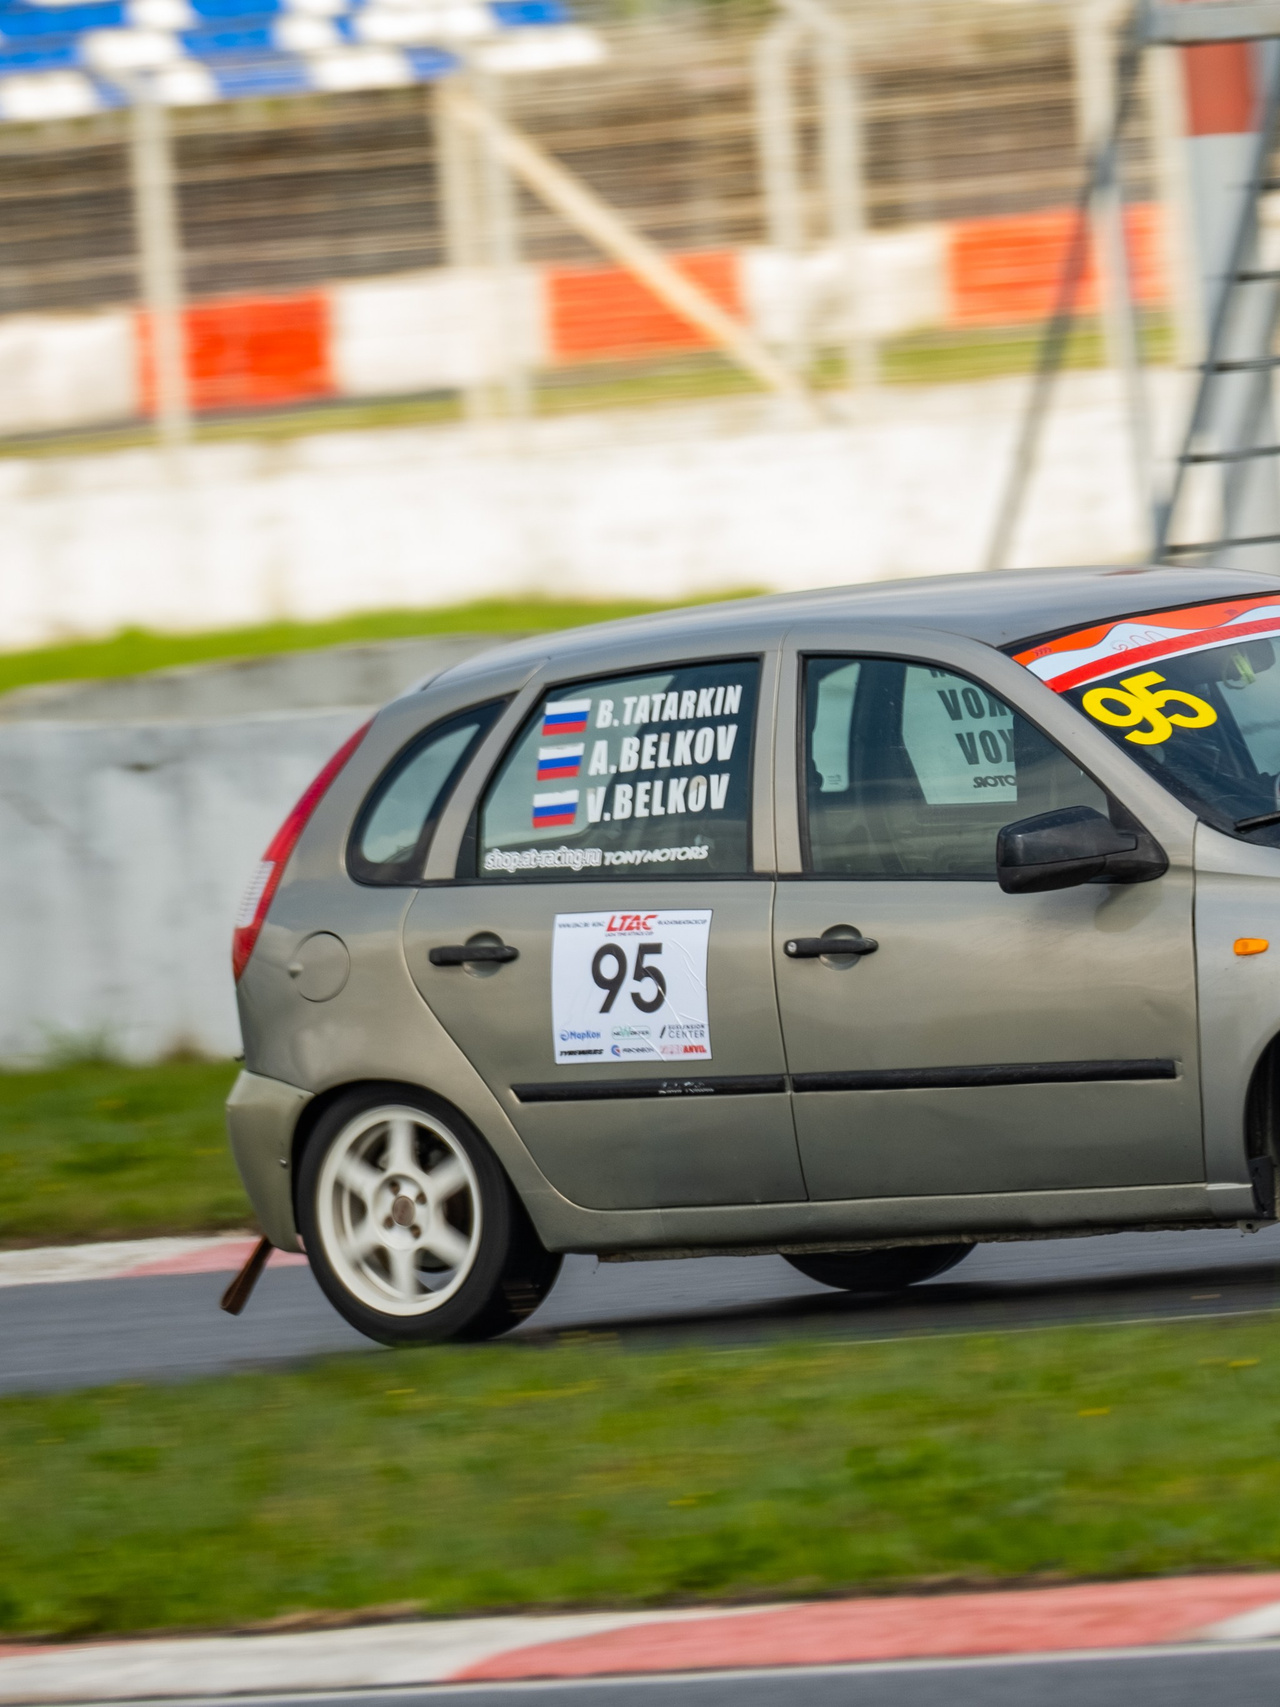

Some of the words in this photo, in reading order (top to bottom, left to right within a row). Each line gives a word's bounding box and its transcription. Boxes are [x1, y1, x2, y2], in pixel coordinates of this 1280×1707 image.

[596, 685, 743, 728] B.TATARKIN
[1082, 671, 1218, 745] 95
[588, 724, 738, 776] A.BELKOV
[586, 773, 730, 823] V.BELKOV
[606, 915, 659, 932] LTAC
[591, 942, 667, 1013] 95
[668, 1029, 705, 1038] CENTER
